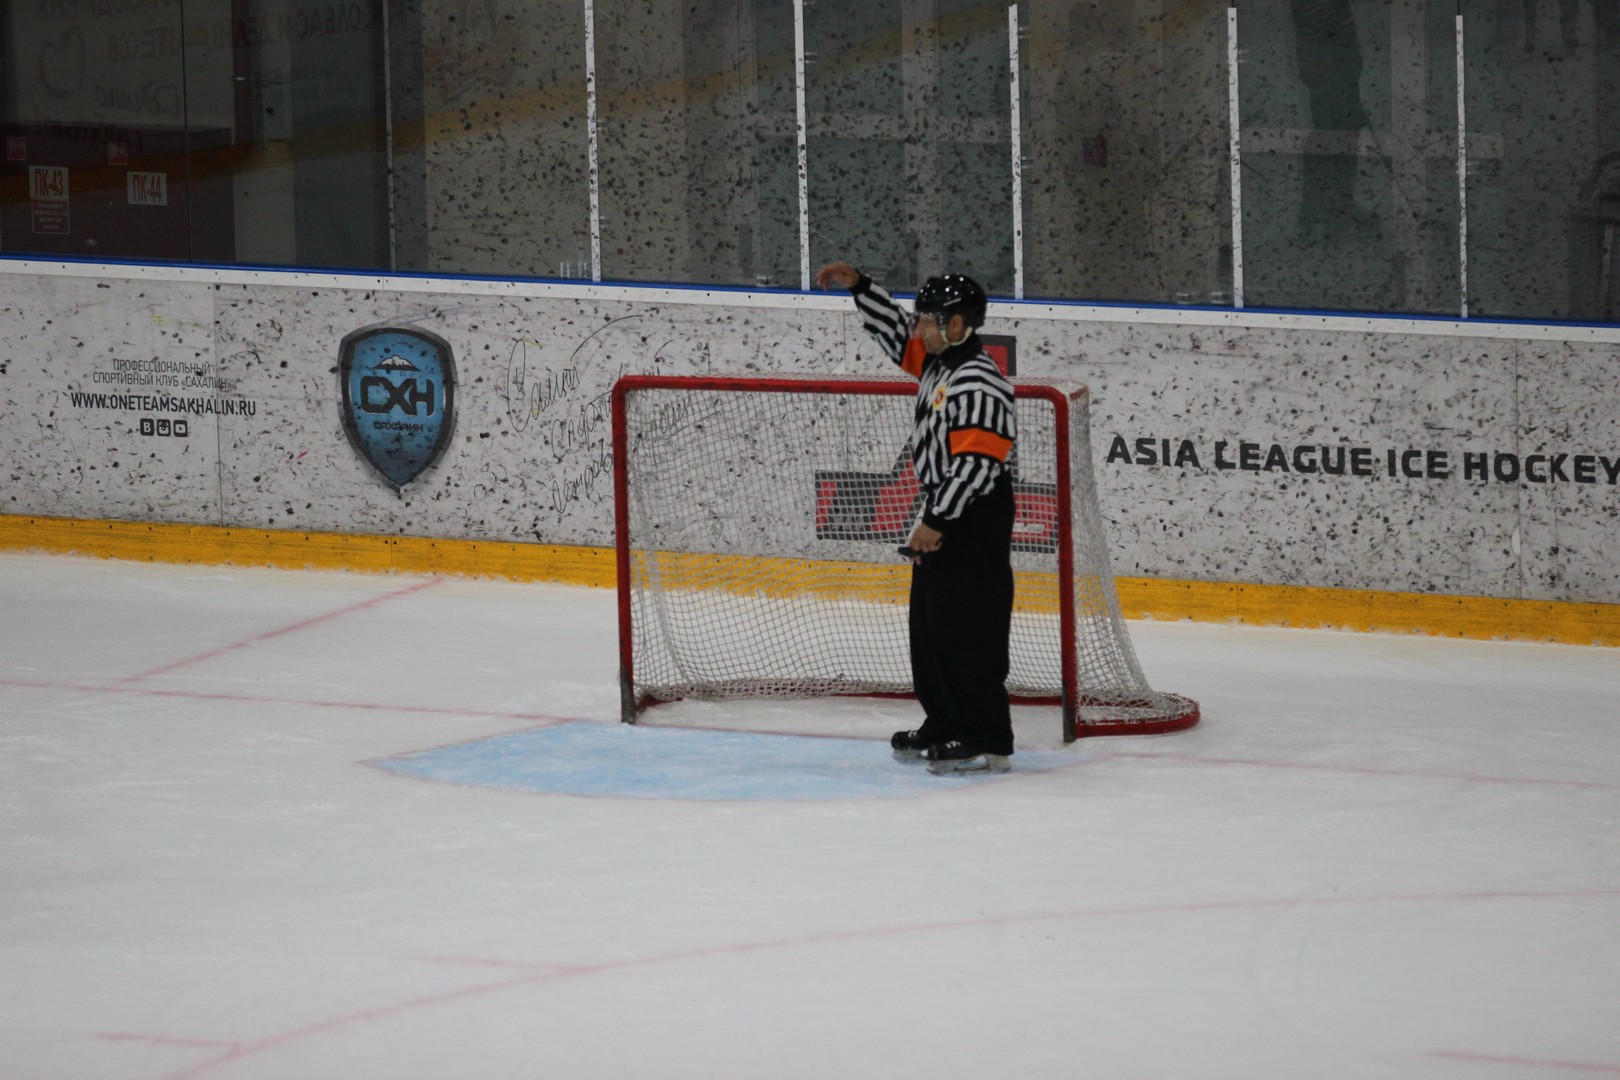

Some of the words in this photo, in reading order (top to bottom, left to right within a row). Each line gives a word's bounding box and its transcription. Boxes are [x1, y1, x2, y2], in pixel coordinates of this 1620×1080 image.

[35, 168, 64, 197] ПК-43
[133, 174, 162, 203] ПК-44
[92, 370, 154, 386] СПОРТИВНЫЙ
[155, 375, 179, 387] КЛУБ
[112, 358, 212, 375] ПРОФЕССИОНАЛЬНЫЙ
[70, 392, 256, 416] WWW.ONETEAMSAKHALIN.RU
[1106, 435, 1202, 468] ASIA
[1214, 440, 1374, 477] LEAGUE
[1388, 448, 1449, 480] ICE
[1463, 452, 1620, 486] HOCKEY
